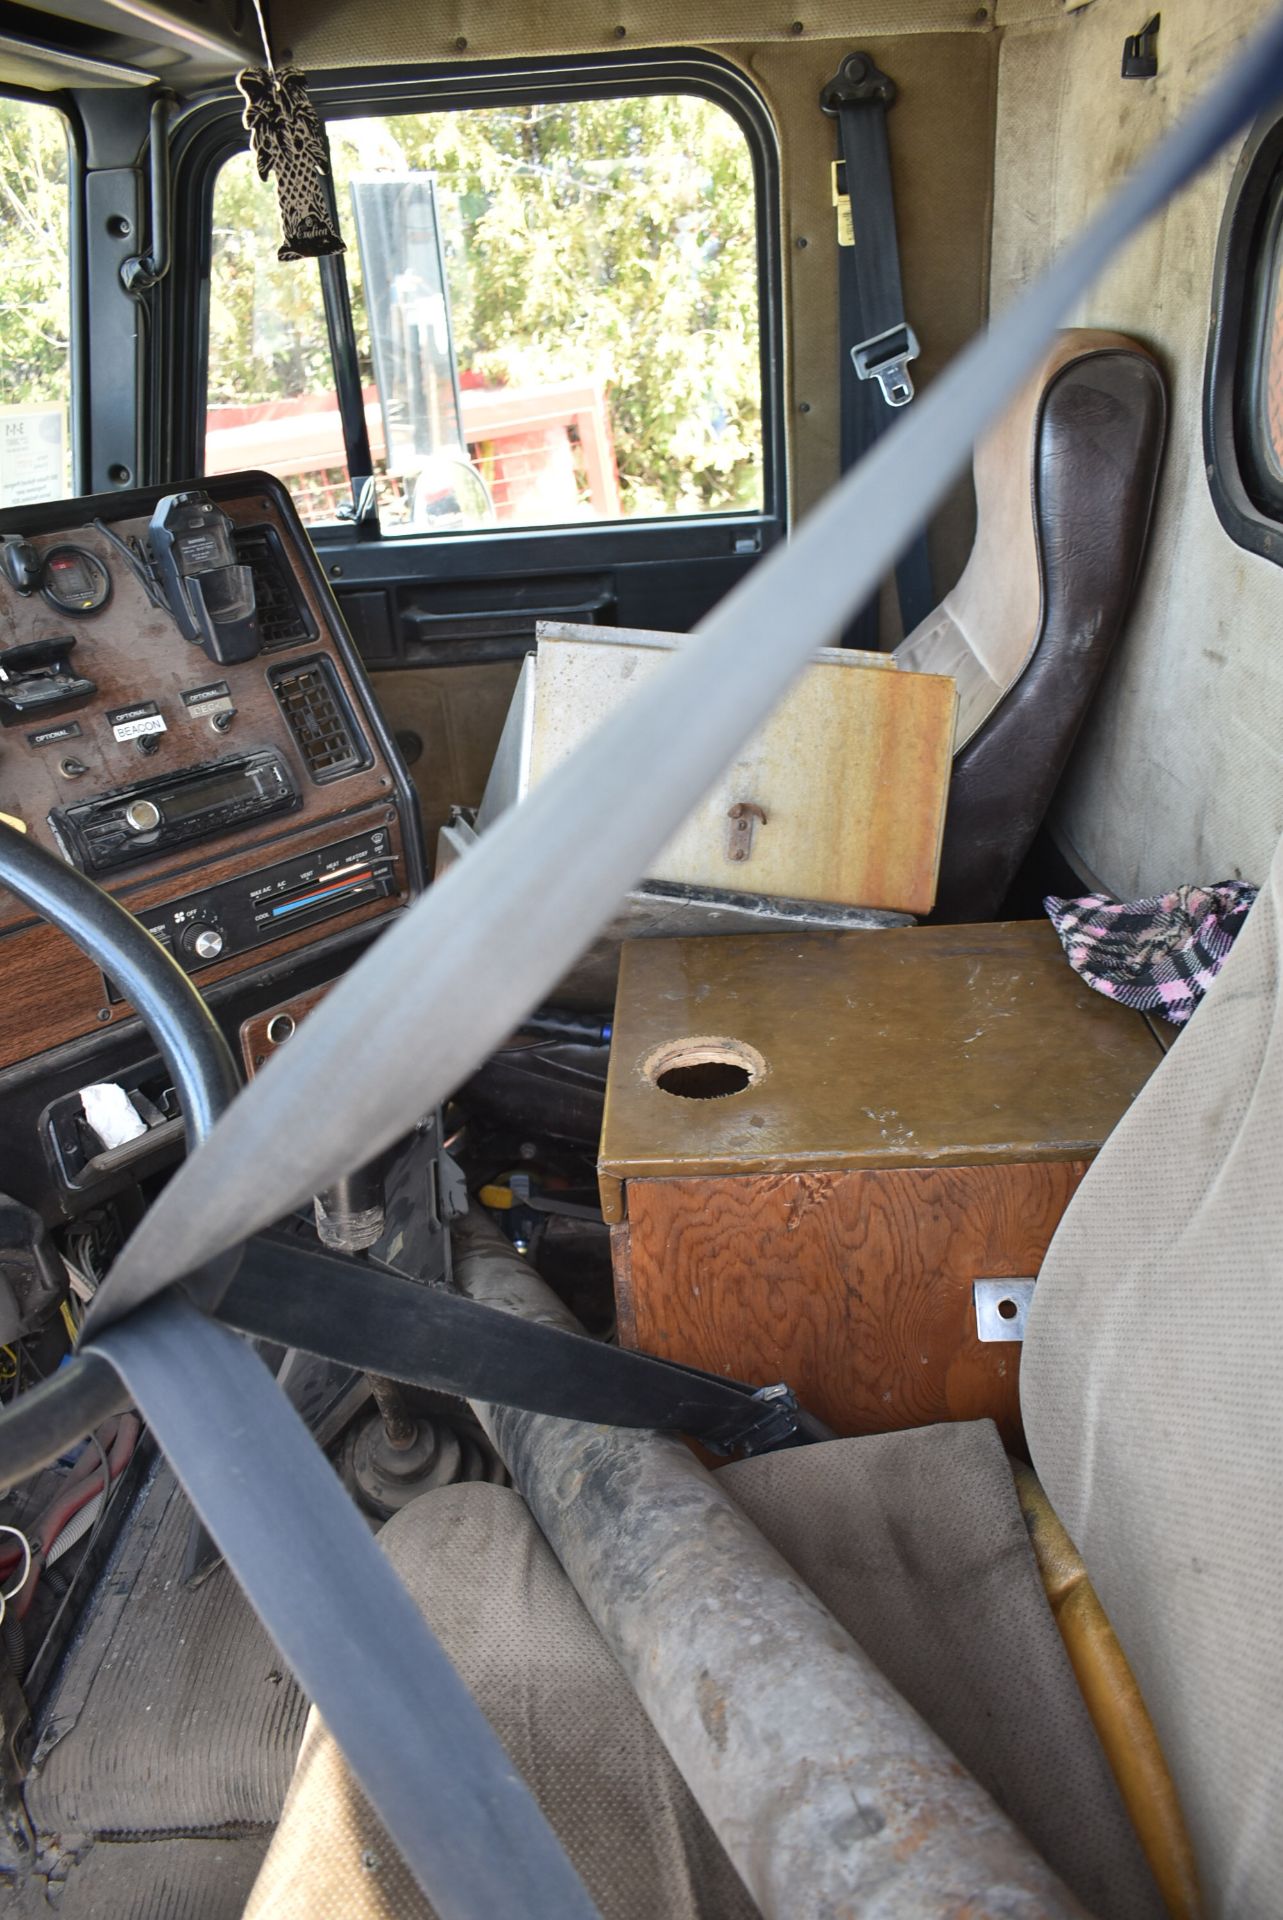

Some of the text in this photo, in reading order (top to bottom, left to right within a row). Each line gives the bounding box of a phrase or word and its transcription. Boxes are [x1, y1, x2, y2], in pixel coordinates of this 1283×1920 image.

[115, 708, 148, 721] OPTIONAL
[194, 702, 222, 715] DECK
[117, 720, 161, 738] BEACON
[35, 729, 70, 743] OPTIONAL
[300, 870, 314, 879] VENT
[186, 908, 198, 917] OFF
[255, 912, 270, 921] COOL
